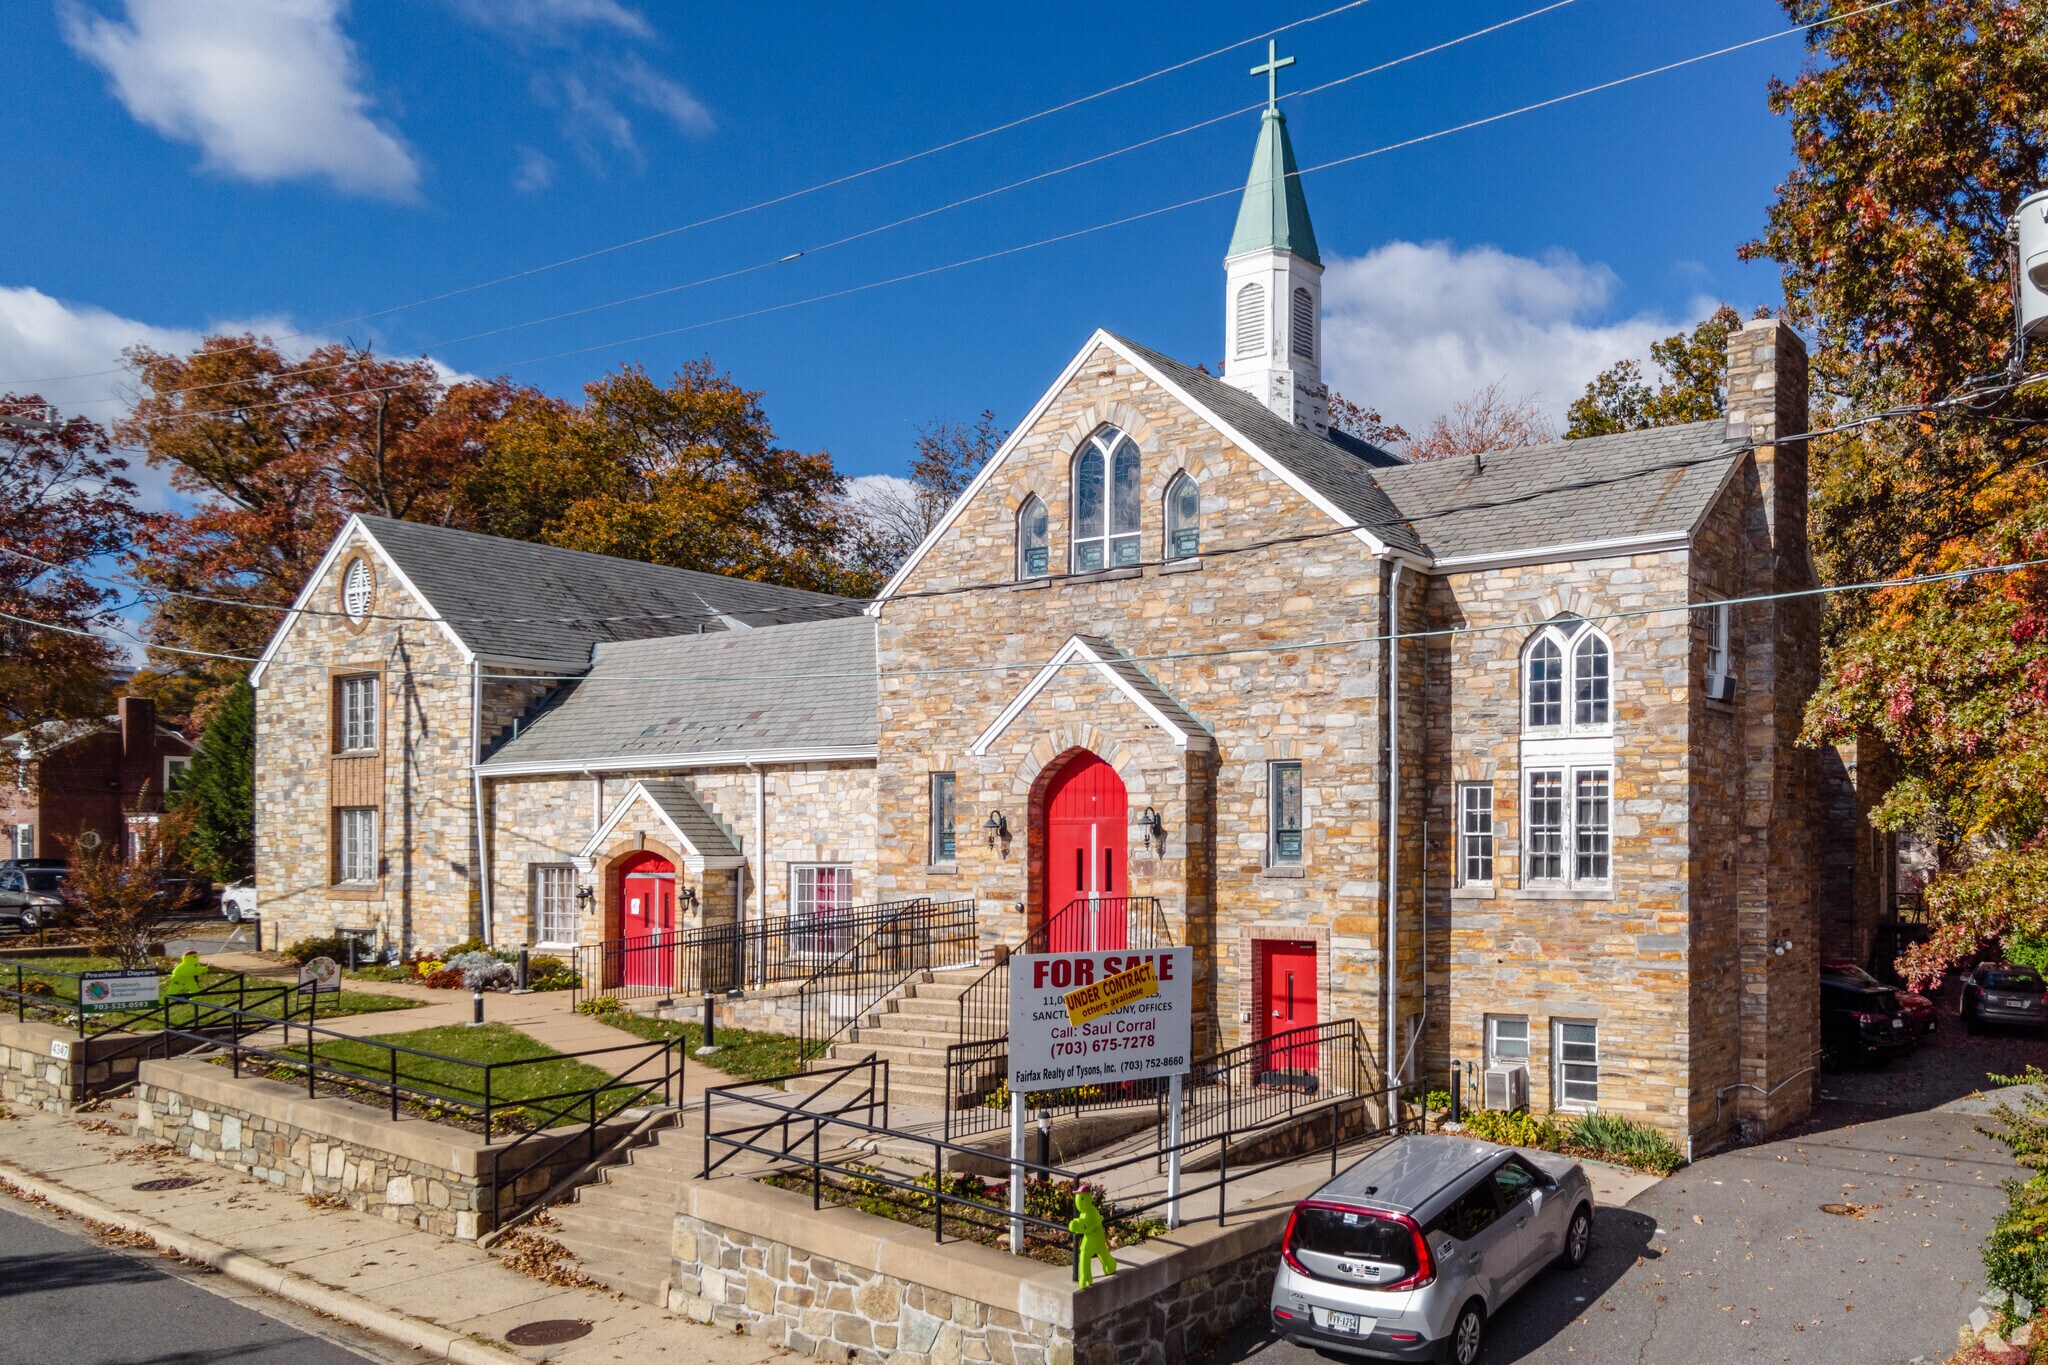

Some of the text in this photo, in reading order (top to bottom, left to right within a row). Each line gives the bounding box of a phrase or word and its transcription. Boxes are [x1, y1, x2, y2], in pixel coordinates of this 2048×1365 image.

[1033, 958, 1094, 989] FOR
[1065, 986, 1101, 1011] UNDER
[1082, 1002, 1108, 1017] others
[1111, 987, 1144, 1006] available
[1138, 1002, 1173, 1013] OFFICES
[1051, 1017, 1156, 1039] Call: Saul Corral
[1050, 1035, 1155, 1059] (703) 675-7278
[1016, 1056, 1184, 1083] Fairfax Realty of Tysons, Inc. (703) 752-8660
